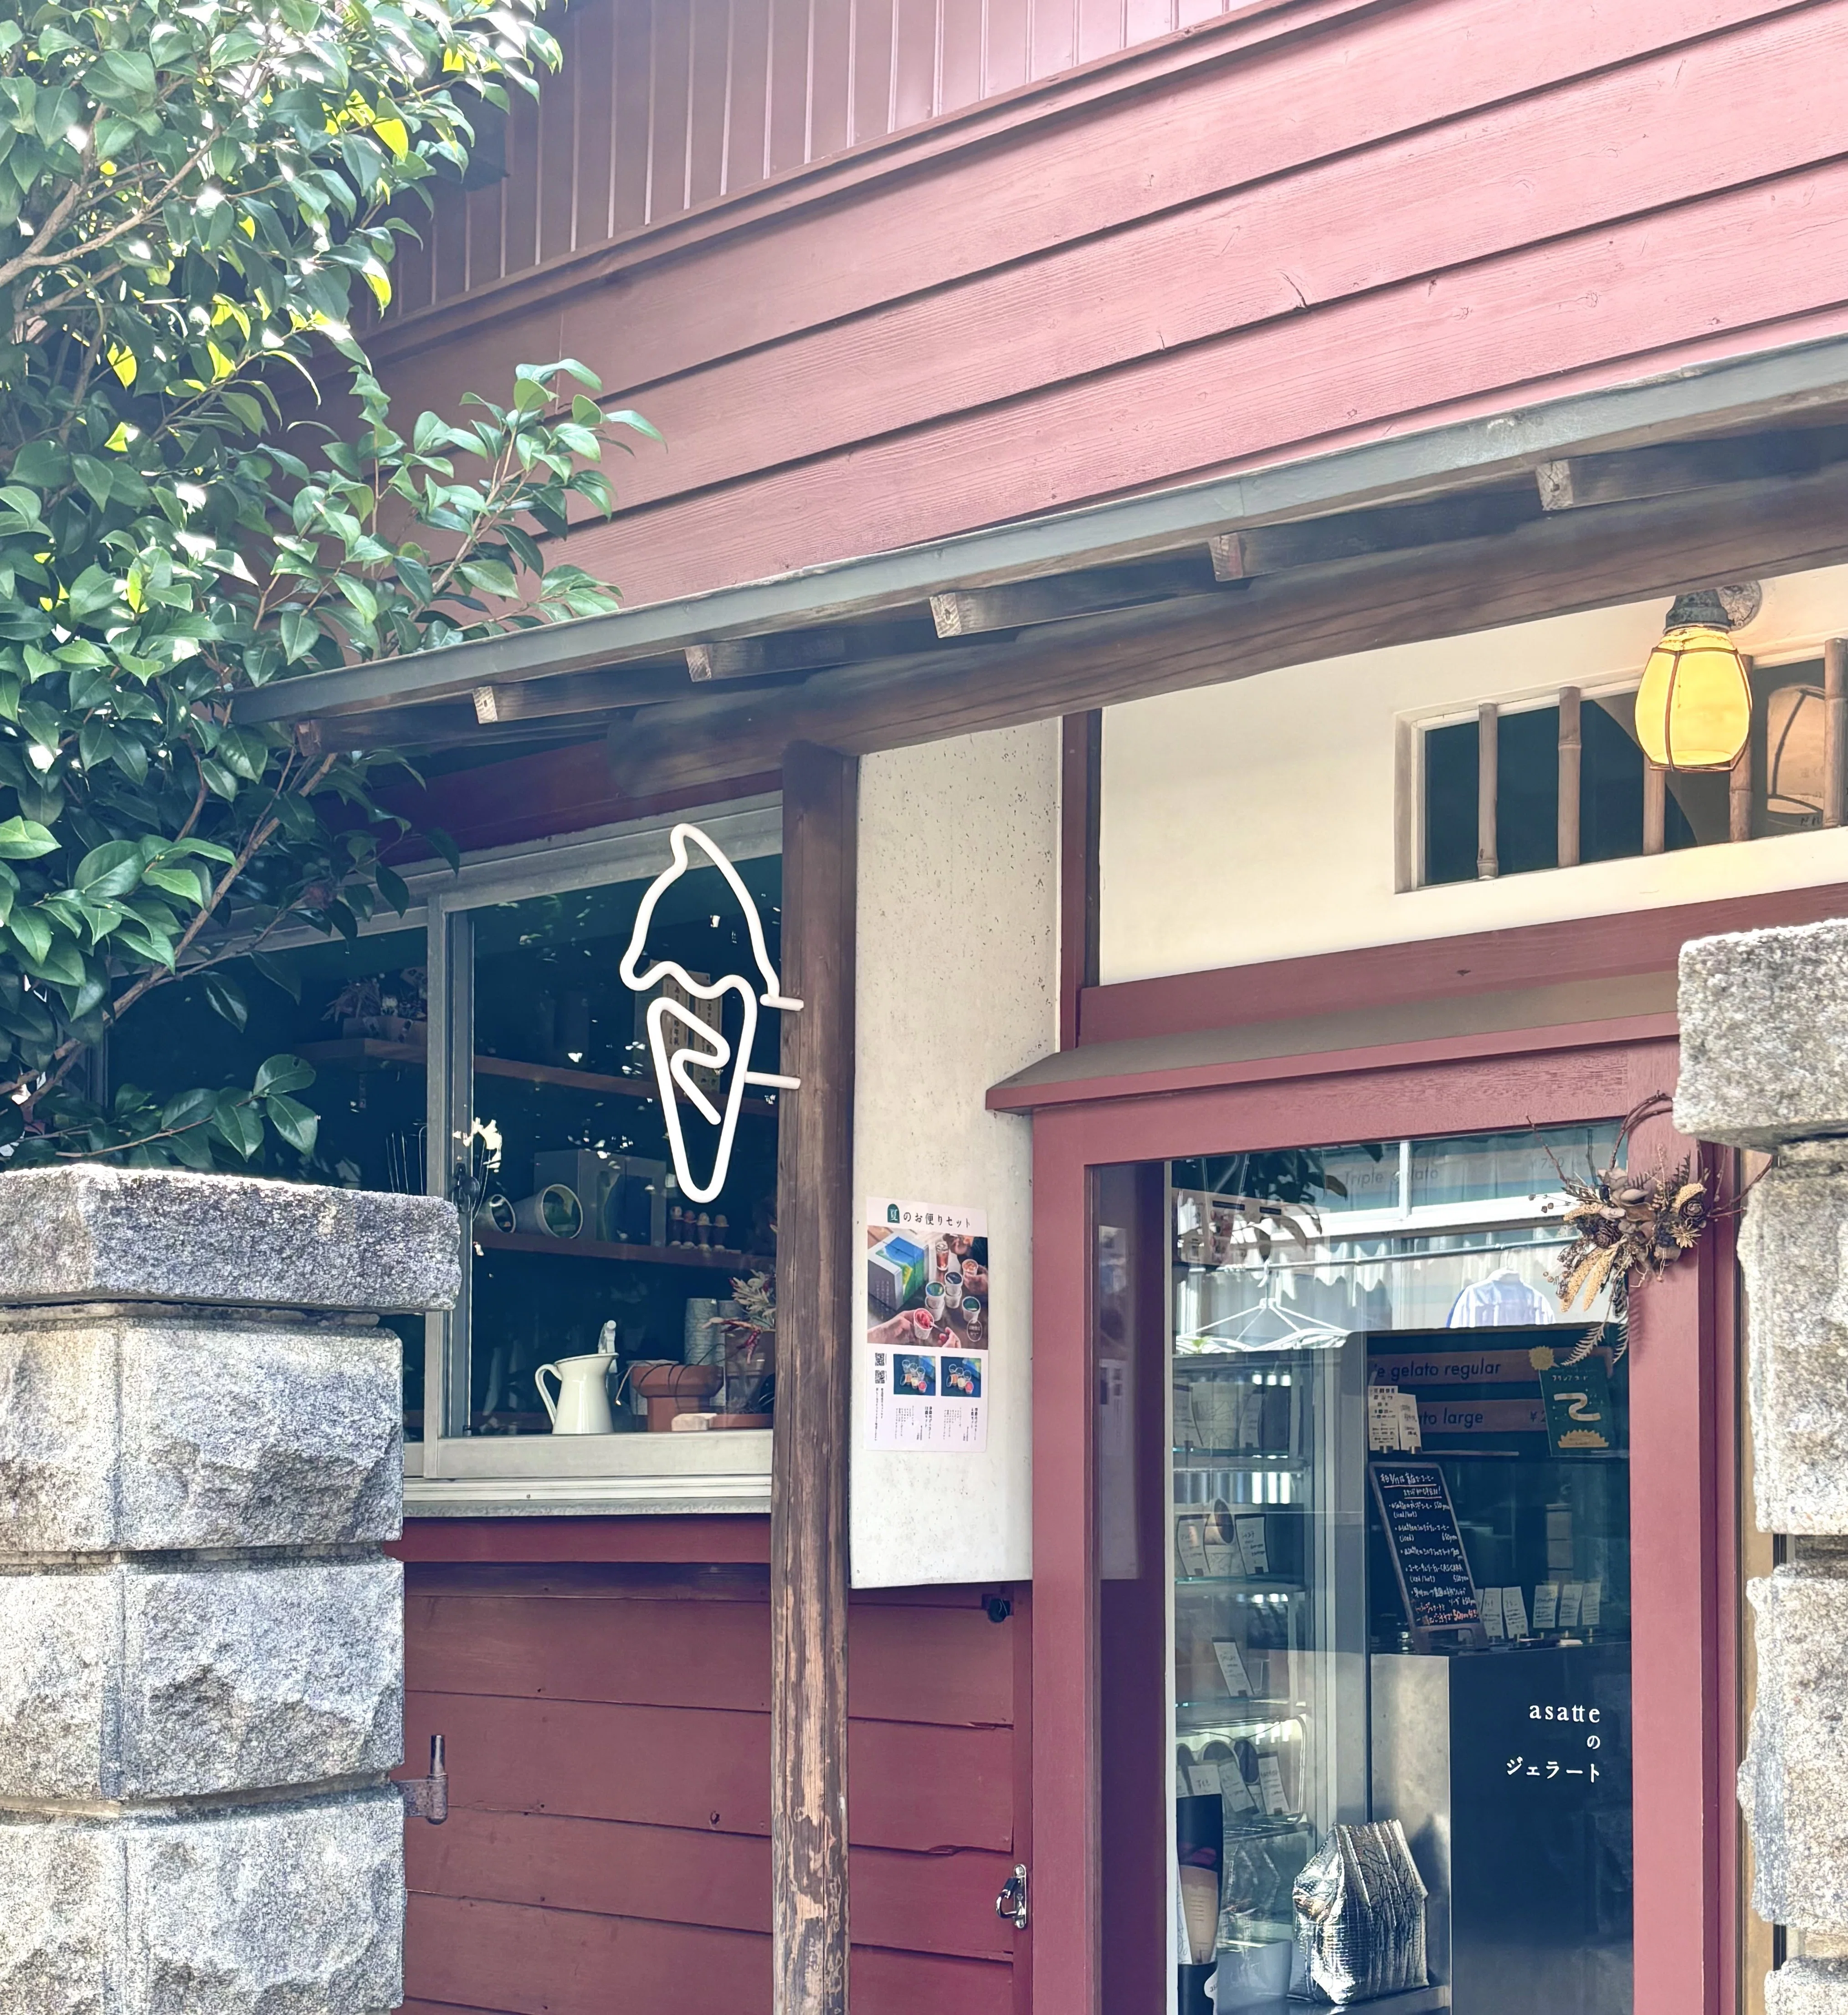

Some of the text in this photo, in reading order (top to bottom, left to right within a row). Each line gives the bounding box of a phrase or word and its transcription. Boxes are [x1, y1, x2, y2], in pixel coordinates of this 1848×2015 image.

[1344, 1166, 1384, 1188] Triple
[890, 1209, 971, 1229] 夏のお便りセット
[1391, 1361, 1438, 1381] gelato
[1444, 1357, 1501, 1380] regular
[1443, 1407, 1484, 1429] large
[1529, 1704, 1600, 1723] asatte
[1586, 1735, 1601, 1749] の
[1506, 1756, 1600, 1784] ジェラート
